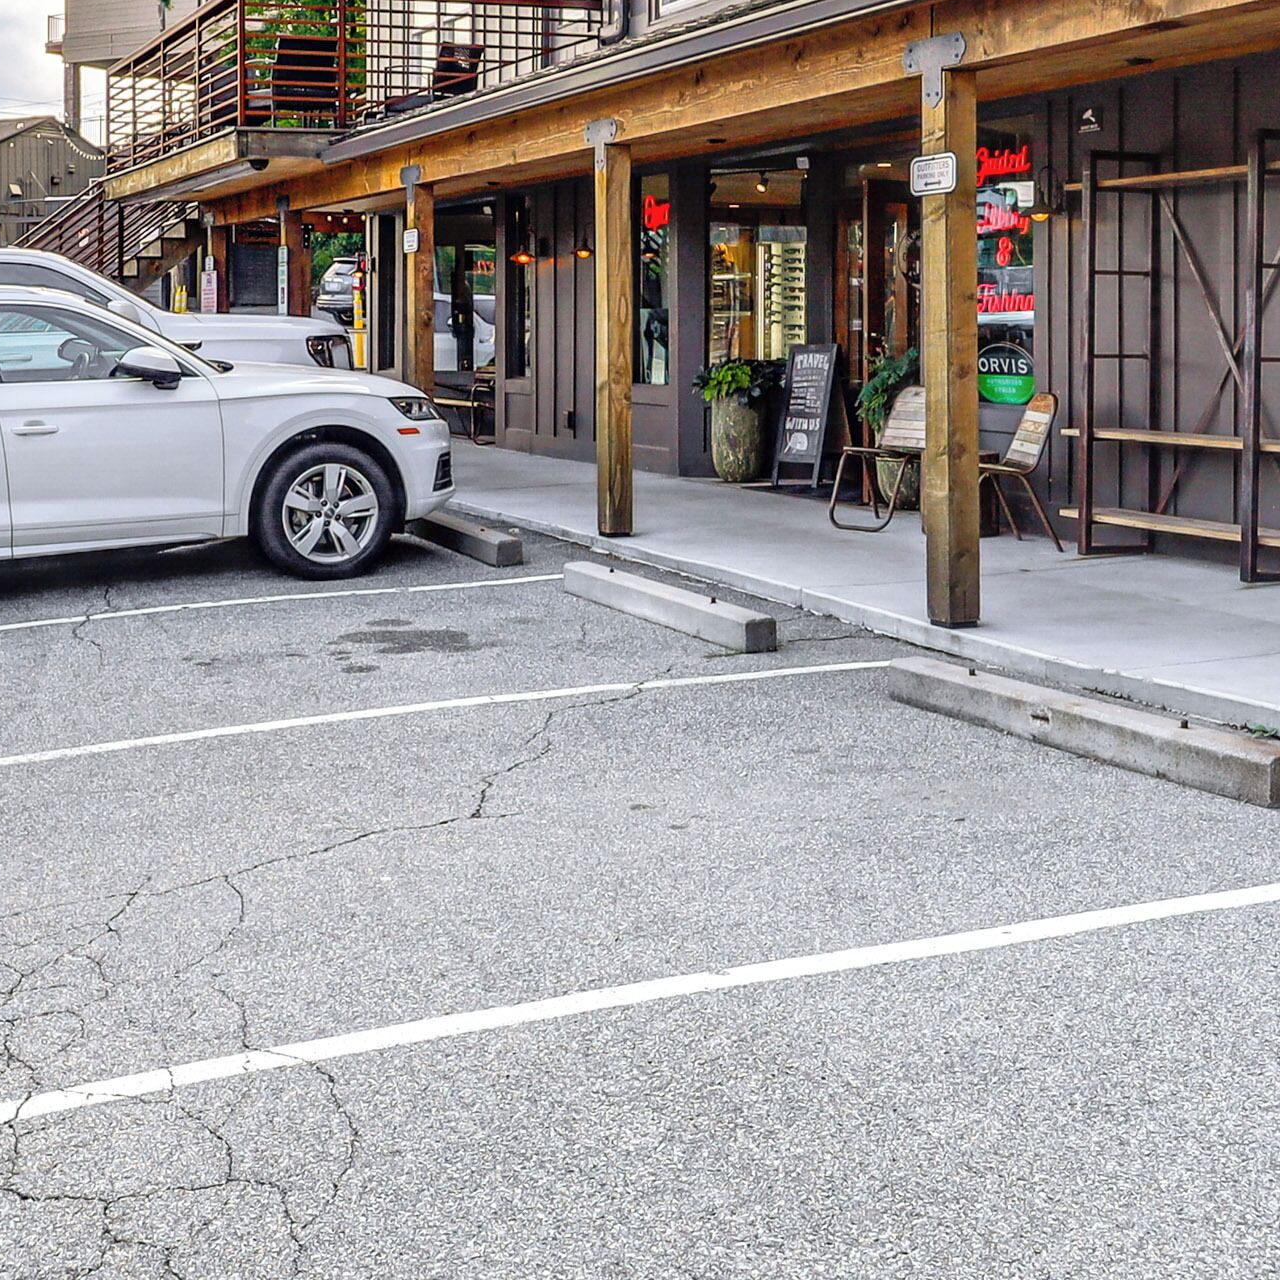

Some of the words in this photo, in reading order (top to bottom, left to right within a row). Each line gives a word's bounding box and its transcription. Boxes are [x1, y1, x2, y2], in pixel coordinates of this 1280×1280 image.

[916, 160, 950, 173] OUTFITTERS
[916, 171, 936, 180] PARKING
[795, 353, 830, 371] TRAVEL
[978, 357, 1028, 374] ORVIS
[785, 416, 809, 431] WITH
